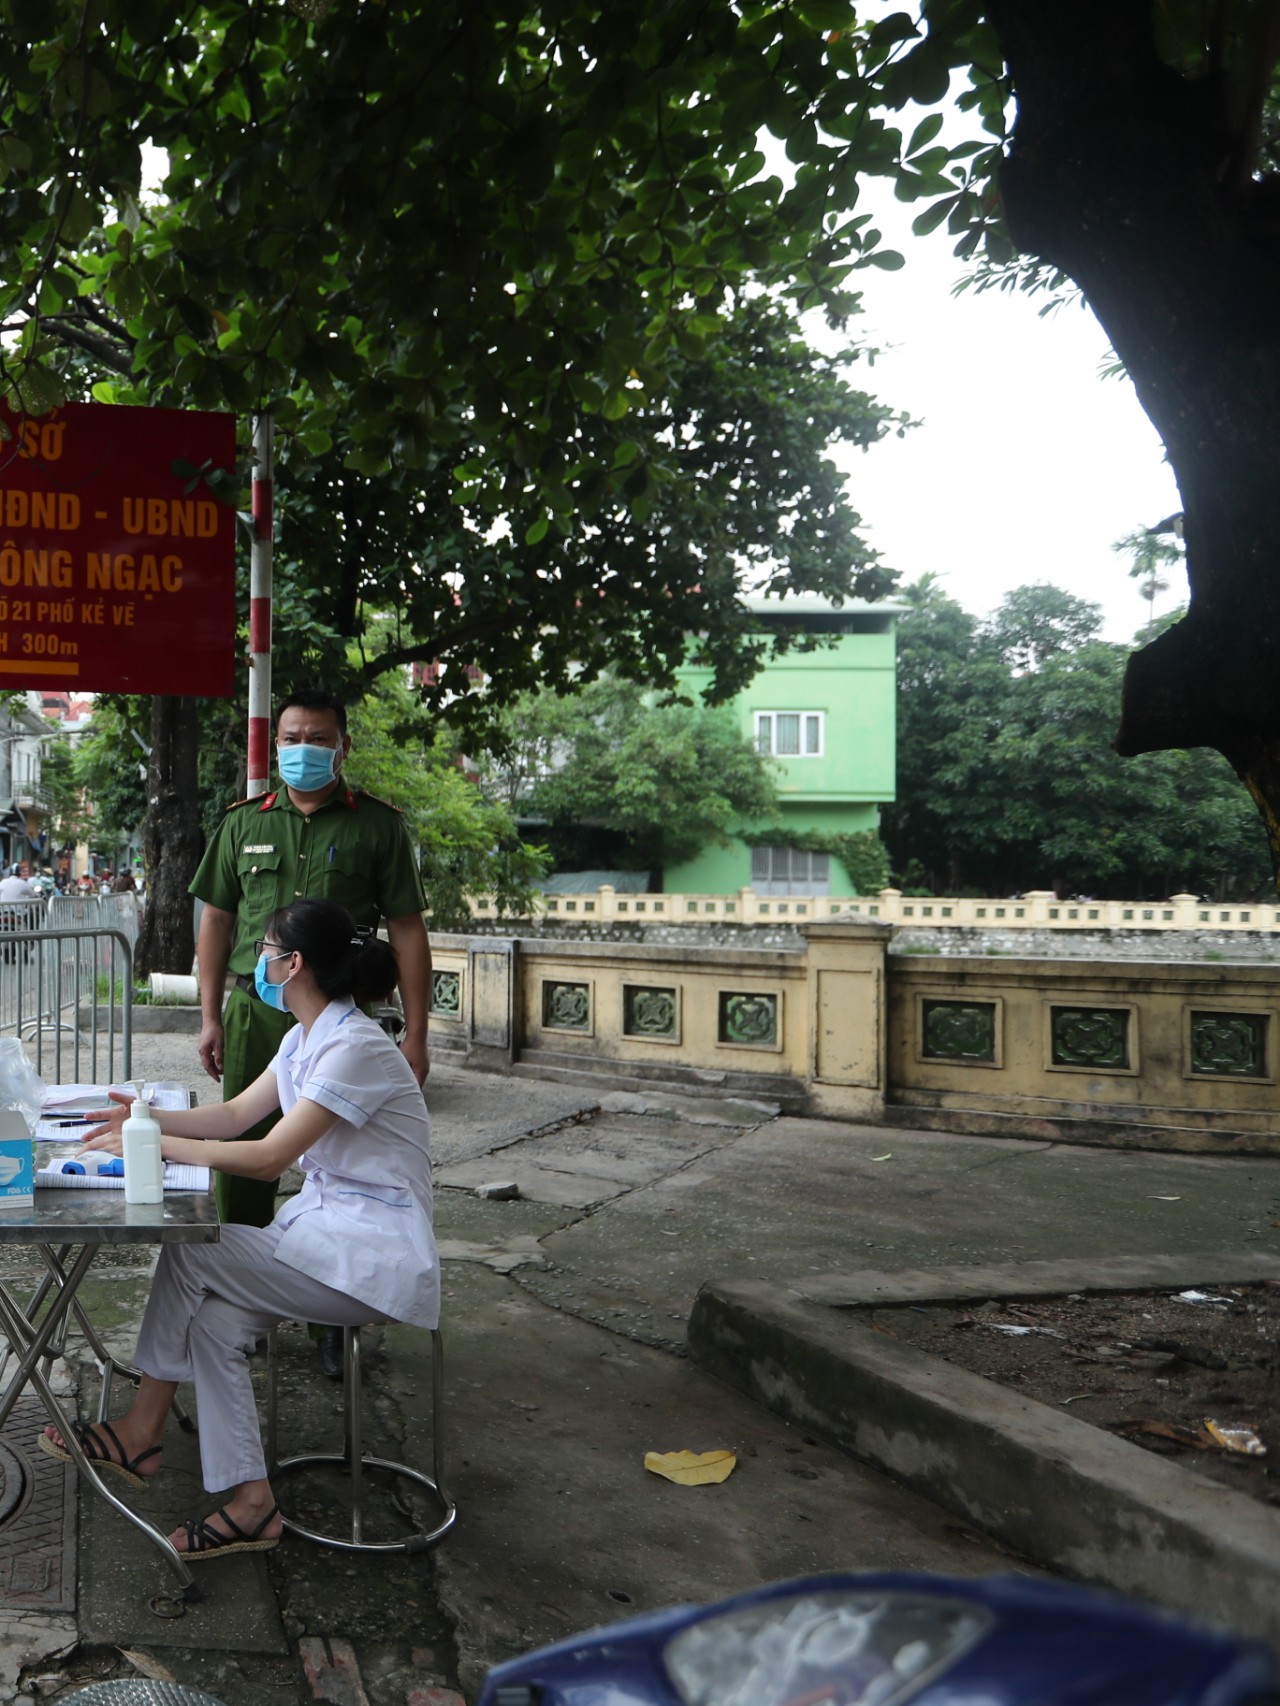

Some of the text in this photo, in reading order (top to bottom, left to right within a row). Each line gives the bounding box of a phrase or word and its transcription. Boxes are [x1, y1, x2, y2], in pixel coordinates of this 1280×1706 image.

[17, 407, 66, 461] SỞ
[122, 497, 218, 538] UBND
[86, 552, 184, 601] NGẠC
[12, 600, 32, 621] 21
[37, 597, 74, 624] PHỐ
[81, 597, 105, 625] KẺ
[112, 602, 136, 626] VẼ
[22, 632, 79, 656] 300m
